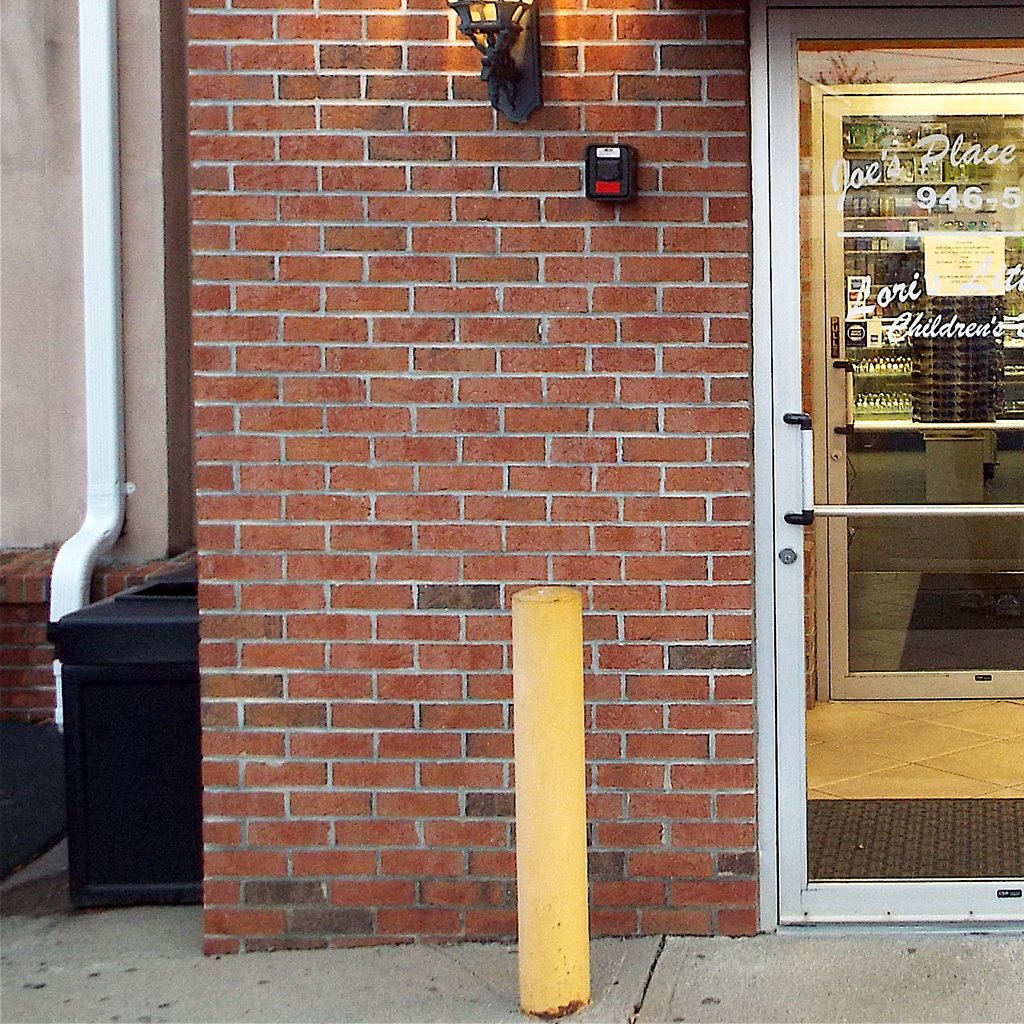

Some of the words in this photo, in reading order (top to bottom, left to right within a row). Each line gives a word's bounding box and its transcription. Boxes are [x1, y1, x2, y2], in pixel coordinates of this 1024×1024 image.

[832, 149, 900, 212] Joe's
[914, 133, 1016, 176] Place
[831, 317, 839, 347] PULL
[886, 311, 1006, 343] Children's
